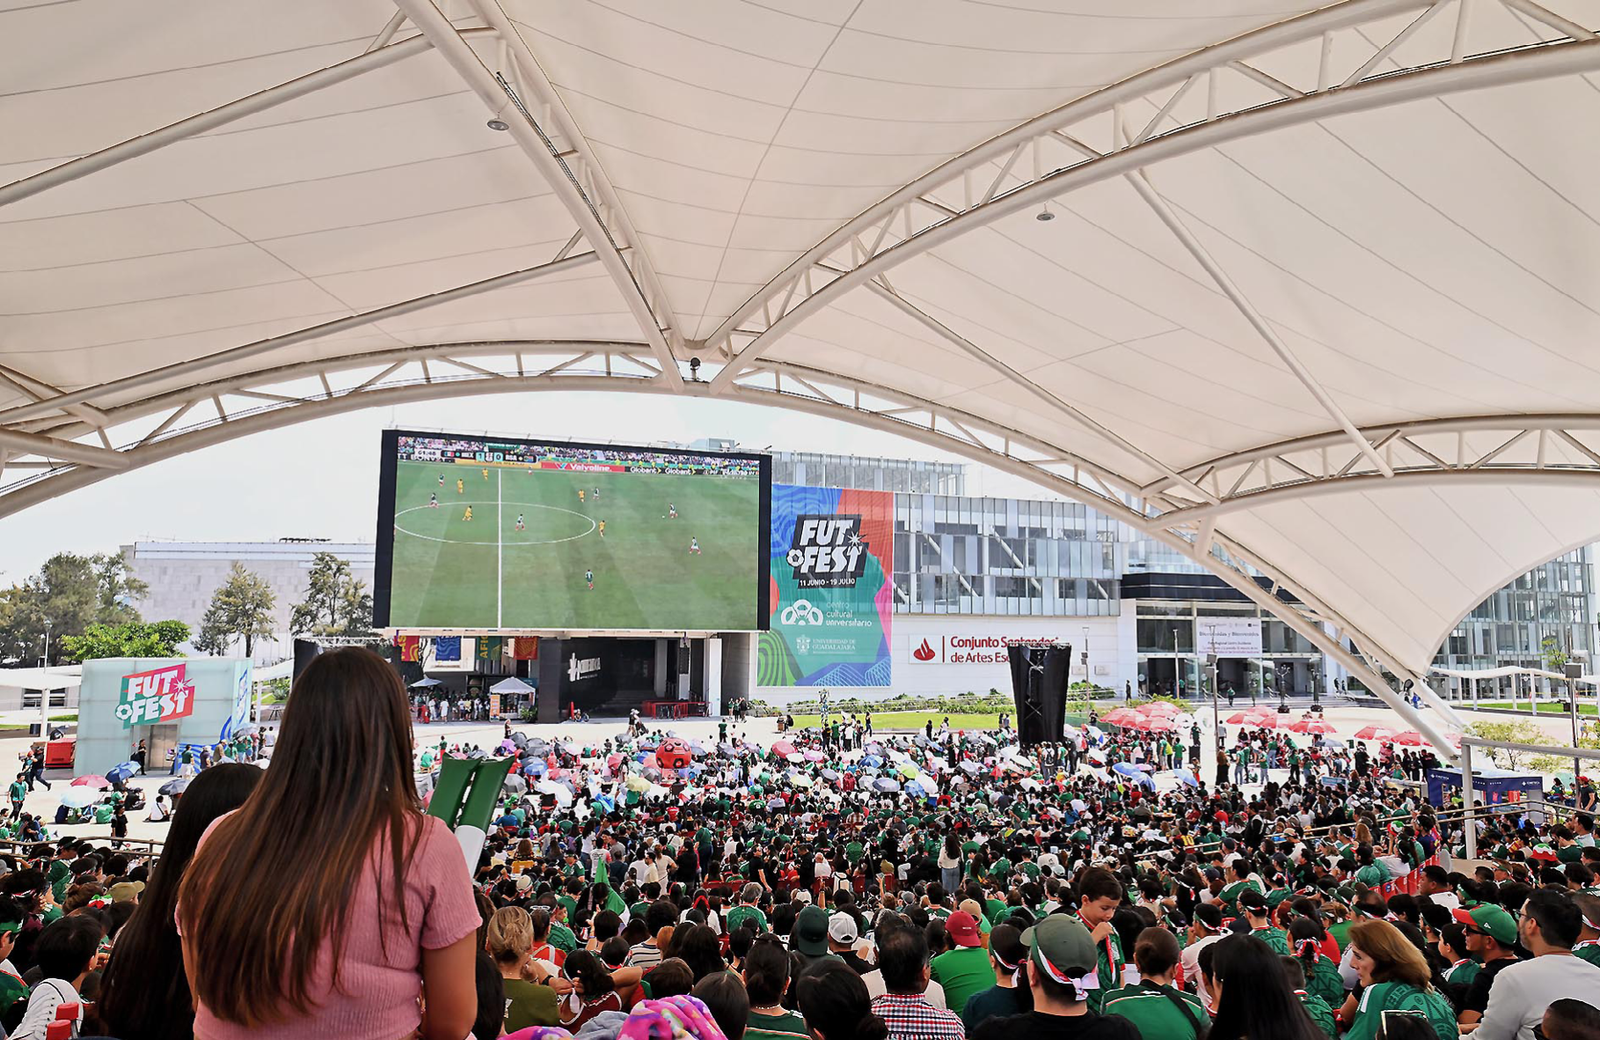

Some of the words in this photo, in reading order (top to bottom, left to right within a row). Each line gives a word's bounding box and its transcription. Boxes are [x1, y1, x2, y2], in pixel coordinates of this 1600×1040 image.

[800, 519, 855, 546] FUT
[800, 546, 863, 573] FEST
[799, 579, 806, 587] 11
[826, 601, 850, 609] centro
[826, 610, 853, 618] cultural
[826, 618, 872, 627] universitario
[950, 636, 999, 650] Conjunto
[950, 652, 964, 663] de
[965, 652, 993, 663] Artes
[127, 669, 178, 701] FUT
[130, 690, 189, 724] FEST
[1181, 834, 1195, 846] 10
